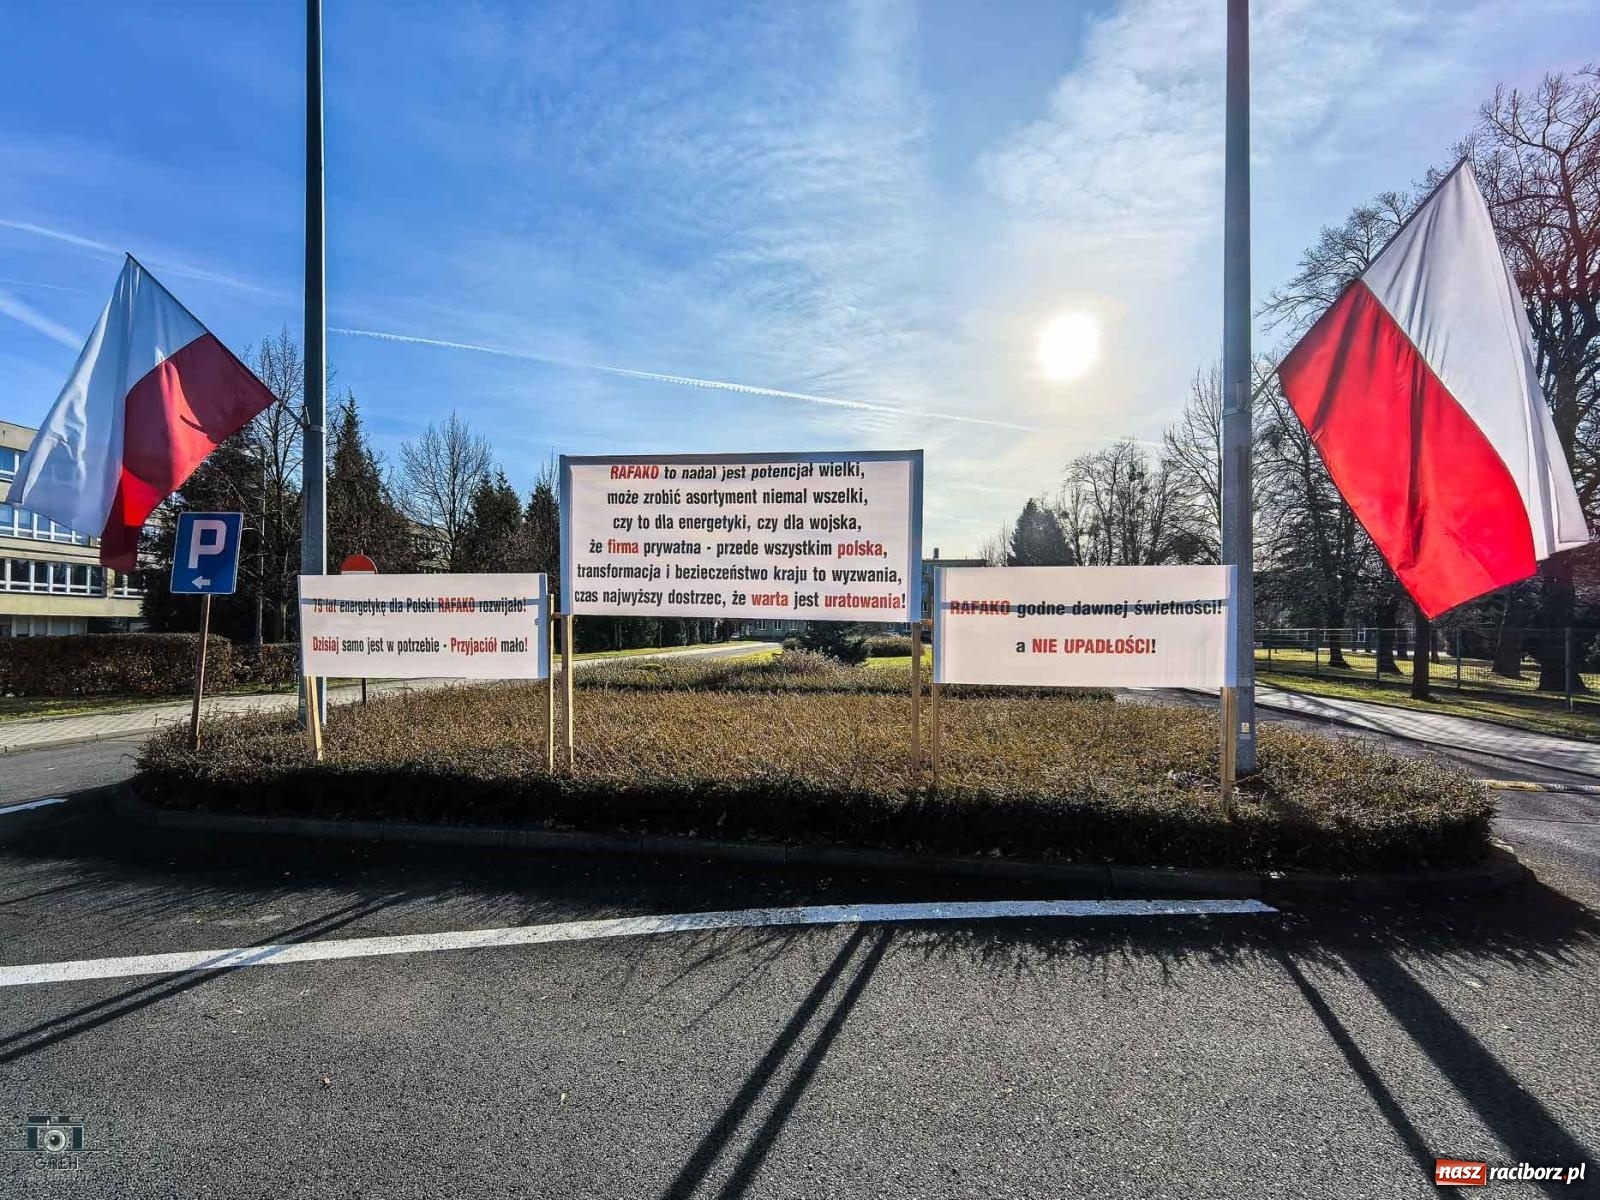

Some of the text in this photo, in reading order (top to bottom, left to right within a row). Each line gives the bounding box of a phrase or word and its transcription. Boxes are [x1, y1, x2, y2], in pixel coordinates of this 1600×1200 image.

[610, 461, 865, 481] RAFAKO to nadal jest potencjał wielki,
[608, 488, 868, 508] może zrobić asortyment niemal wszelki,
[613, 514, 862, 532] czy to dla energetyki, czy dla wojska,
[188, 520, 226, 568] P
[589, 539, 602, 554] że
[608, 539, 639, 554] firma
[644, 540, 701, 557] prywatna
[716, 540, 758, 558] przede
[764, 540, 832, 558] wszystkim
[838, 540, 888, 559] polska,
[577, 564, 902, 585] transformacja i bezieczeństwo kraju to wyzwania,
[312, 597, 526, 616] 75 lat energetykę dla Polski RAFAKO rozwijało!
[574, 588, 906, 609] czas najwyższy dostrzec, że warta jest uratowania!
[950, 600, 1222, 618] RAFAKO godne dawnej świetności!
[312, 636, 339, 654] Dzisiaj
[342, 640, 364, 652] samo
[367, 636, 384, 655] jest
[386, 640, 394, 652] w
[398, 637, 440, 656] potrzebie
[450, 636, 498, 656] Przyjaciół
[500, 637, 528, 652] mało!
[1016, 634, 1156, 654] a NIE UPADŁOŚCI!
